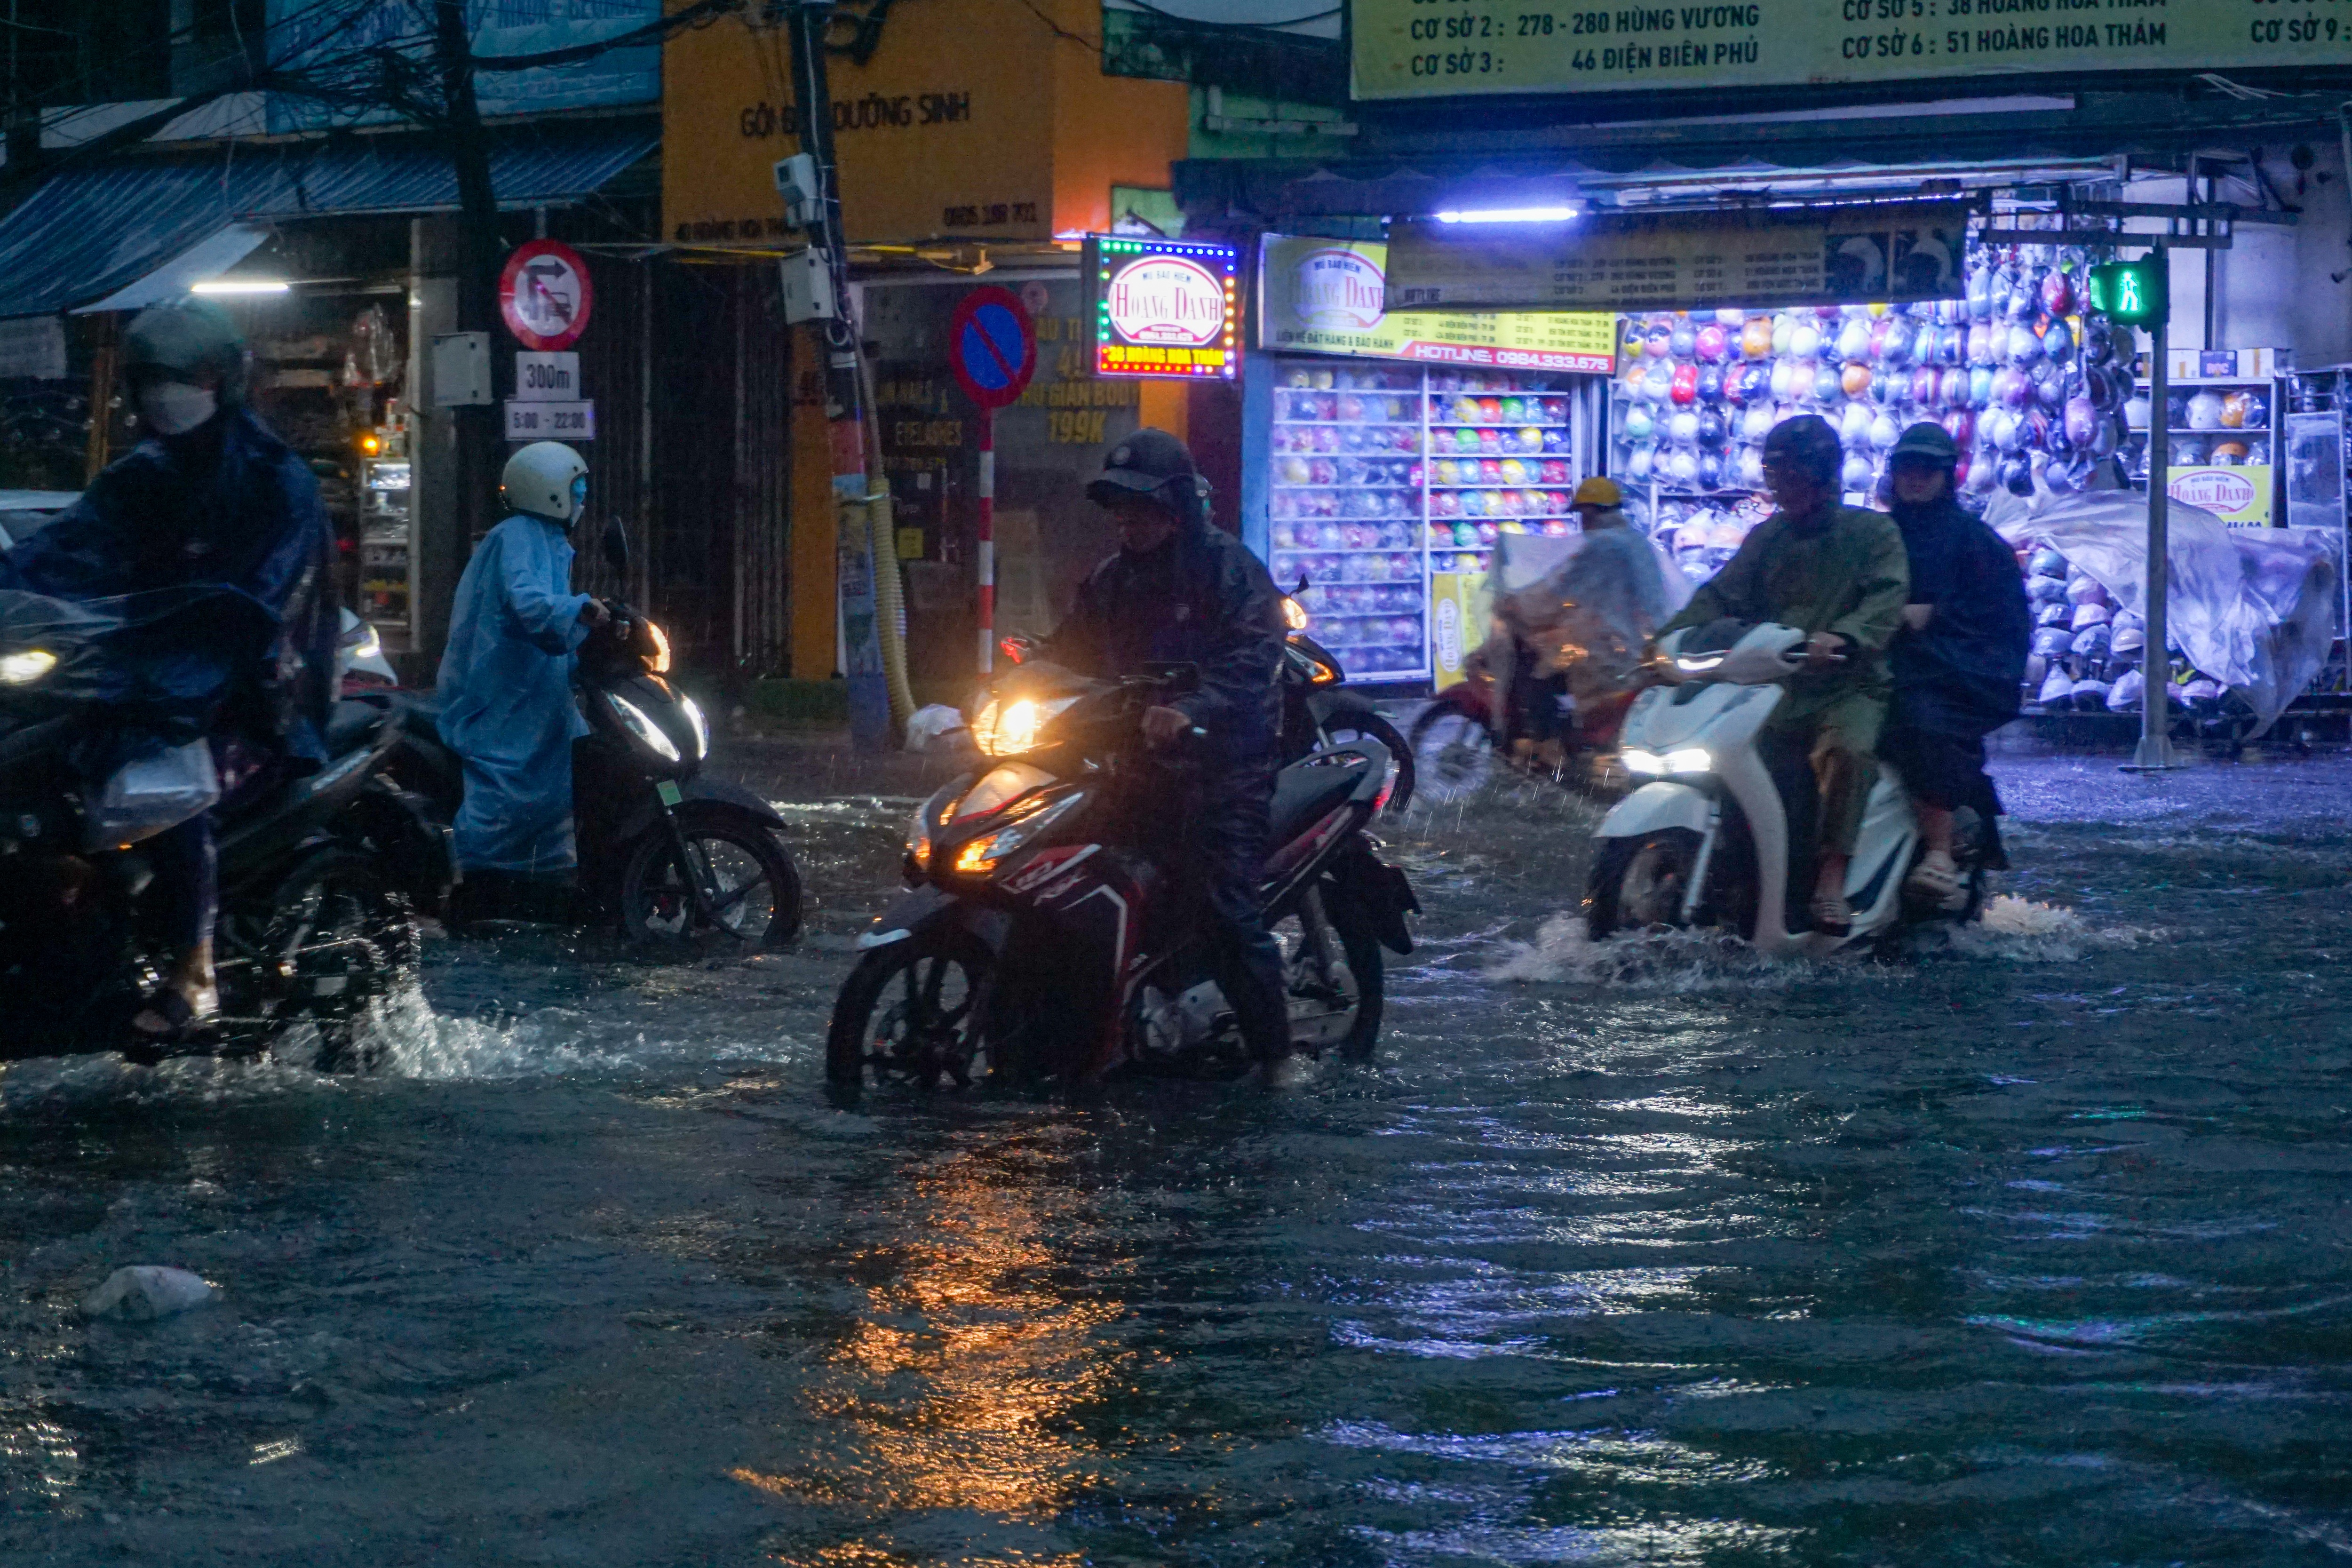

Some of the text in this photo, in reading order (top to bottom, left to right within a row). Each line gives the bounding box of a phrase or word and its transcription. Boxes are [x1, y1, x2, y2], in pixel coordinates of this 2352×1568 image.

[1411, 17, 1441, 40] CƠ
[1446, 10, 1477, 38] SỞ
[1480, 15, 1491, 37] 2
[1518, 14, 1553, 36] 278
[1573, 12, 1610, 34] 280
[1616, 6, 1675, 32] HÙNG
[1681, 5, 1760, 29] VƯƠNG
[1843, 36, 1872, 59] CƠ
[1877, 27, 1907, 57] SỞ
[1911, 32, 1923, 55] 6
[1948, 31, 1970, 53] 51
[1977, 23, 2049, 52] HOÀNG
[2055, 24, 2099, 48] HOA
[2105, 17, 2166, 47] THÁM
[2251, 18, 2283, 43] CƠ
[2288, 12, 2321, 42] SỞ
[2326, 18, 2338, 41] 9
[1411, 53, 1441, 76] CƠ
[1446, 46, 1476, 74] SỞ
[1479, 51, 1492, 73] 3
[1572, 49, 1597, 71] 46
[1602, 42, 1652, 73] ĐIỆN
[1658, 40, 1708, 67] BIÊN
[1714, 34, 1759, 65] PHỦ
[918, 91, 970, 125] SINH
[1415, 344, 1609, 370] HOTLINE: 0984.333.675
[527, 364, 570, 389] 300m
[1049, 410, 1108, 443] 199K
[2216, 484, 2250, 501] DANH
